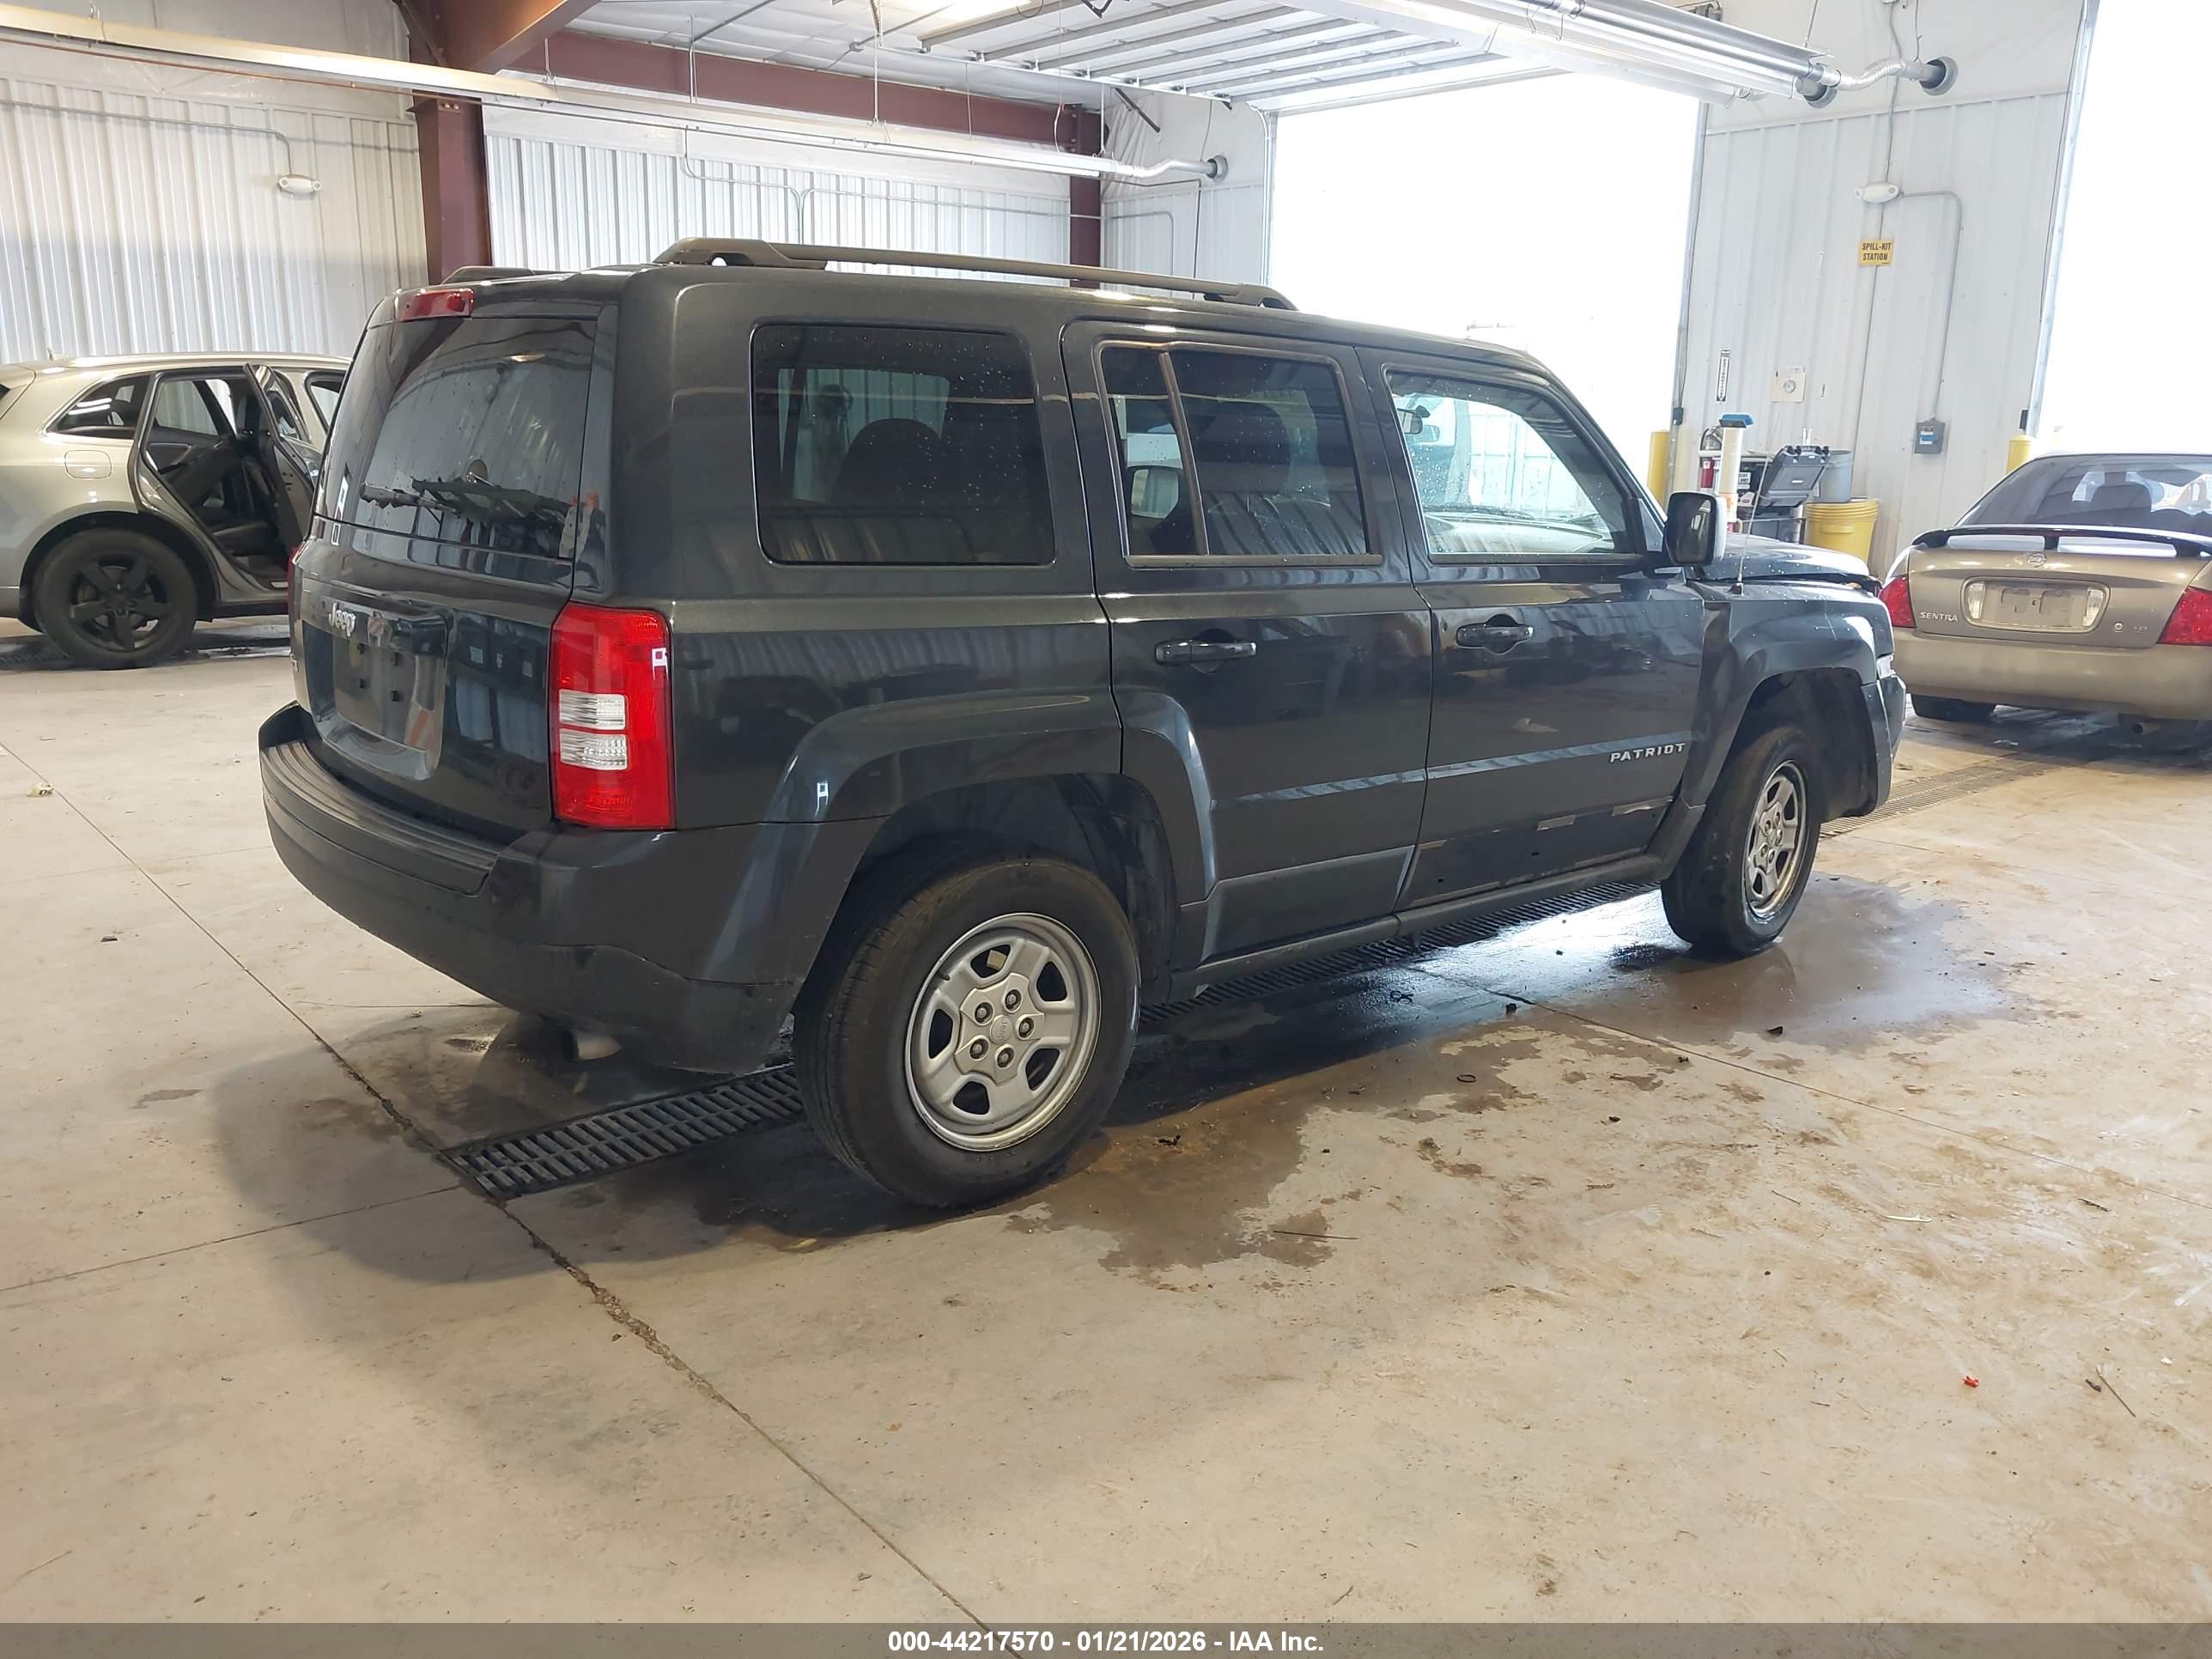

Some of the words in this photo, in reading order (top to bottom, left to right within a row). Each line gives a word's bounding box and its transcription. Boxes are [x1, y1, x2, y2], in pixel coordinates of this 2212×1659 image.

[1862, 242, 1892, 251] SPILL-KIT
[1863, 252, 1888, 261] STATION
[329, 602, 356, 637] Jeep
[1918, 611, 1959, 622] SENTRA
[1609, 742, 1686, 763] PATRIOT
